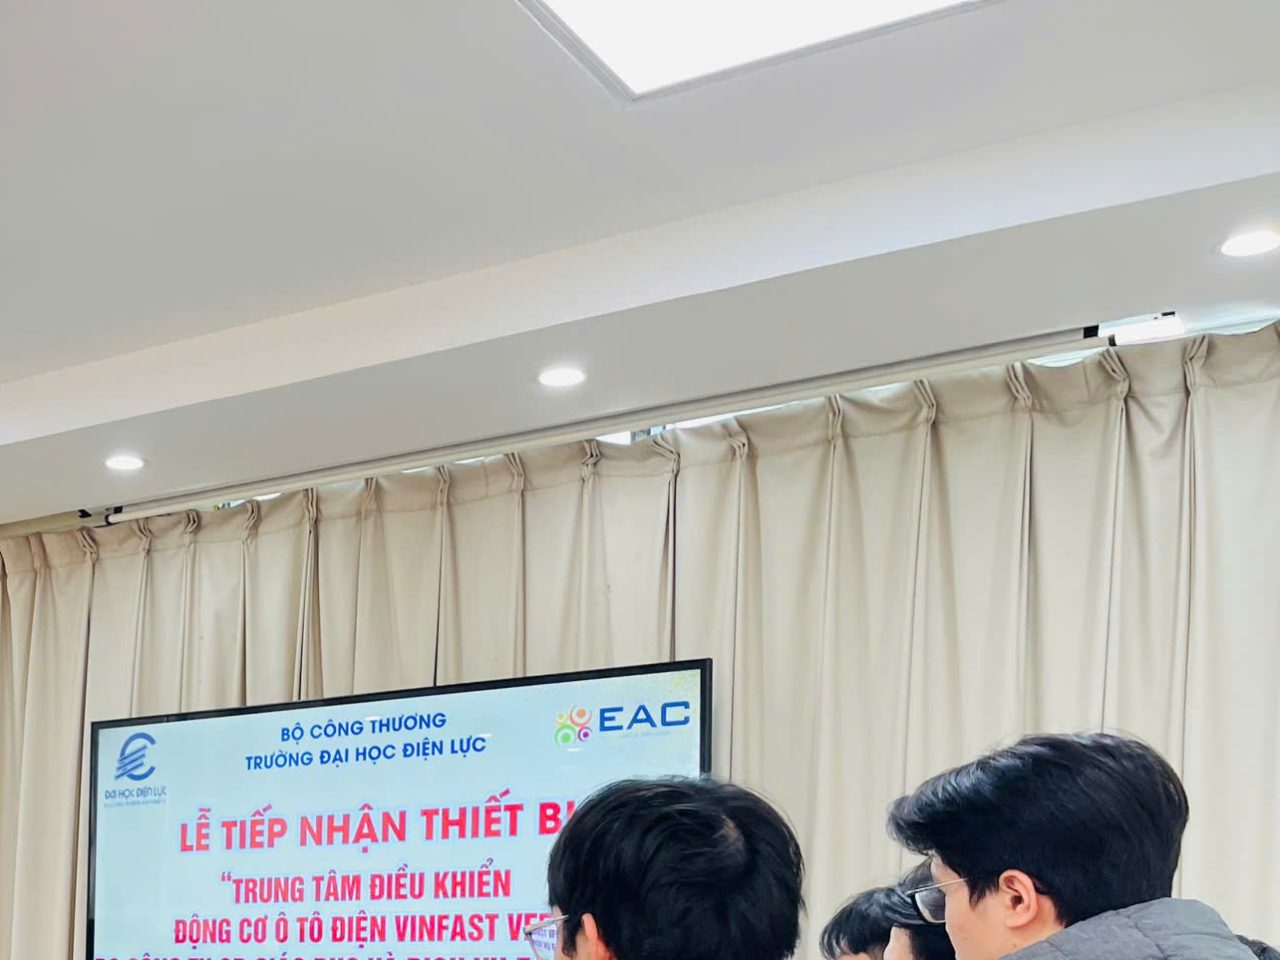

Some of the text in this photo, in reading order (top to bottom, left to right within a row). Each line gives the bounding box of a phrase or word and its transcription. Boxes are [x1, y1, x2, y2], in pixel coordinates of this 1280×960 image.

[281, 712, 447, 744] BỘ CÔNG THƯƠNG
[599, 701, 690, 732] EAC
[246, 735, 487, 770] TRƯỜNG ĐẠI HỌC ĐIỆN LỰC
[180, 808, 211, 852] LỄ
[221, 804, 288, 850] TIẾP
[299, 802, 407, 854] NHẬN
[420, 788, 525, 841] THIẾT
[312, 868, 361, 901] TÂM
[369, 862, 424, 900] ĐIỀU
[434, 857, 511, 898] KHIỂN
[174, 913, 231, 950] ĐỘNG
[239, 914, 268, 944] CƠ
[275, 911, 289, 944] Ô
[296, 911, 324, 944] TÔ
[331, 909, 386, 949] ĐIỆN
[395, 913, 499, 942] VINFAST
